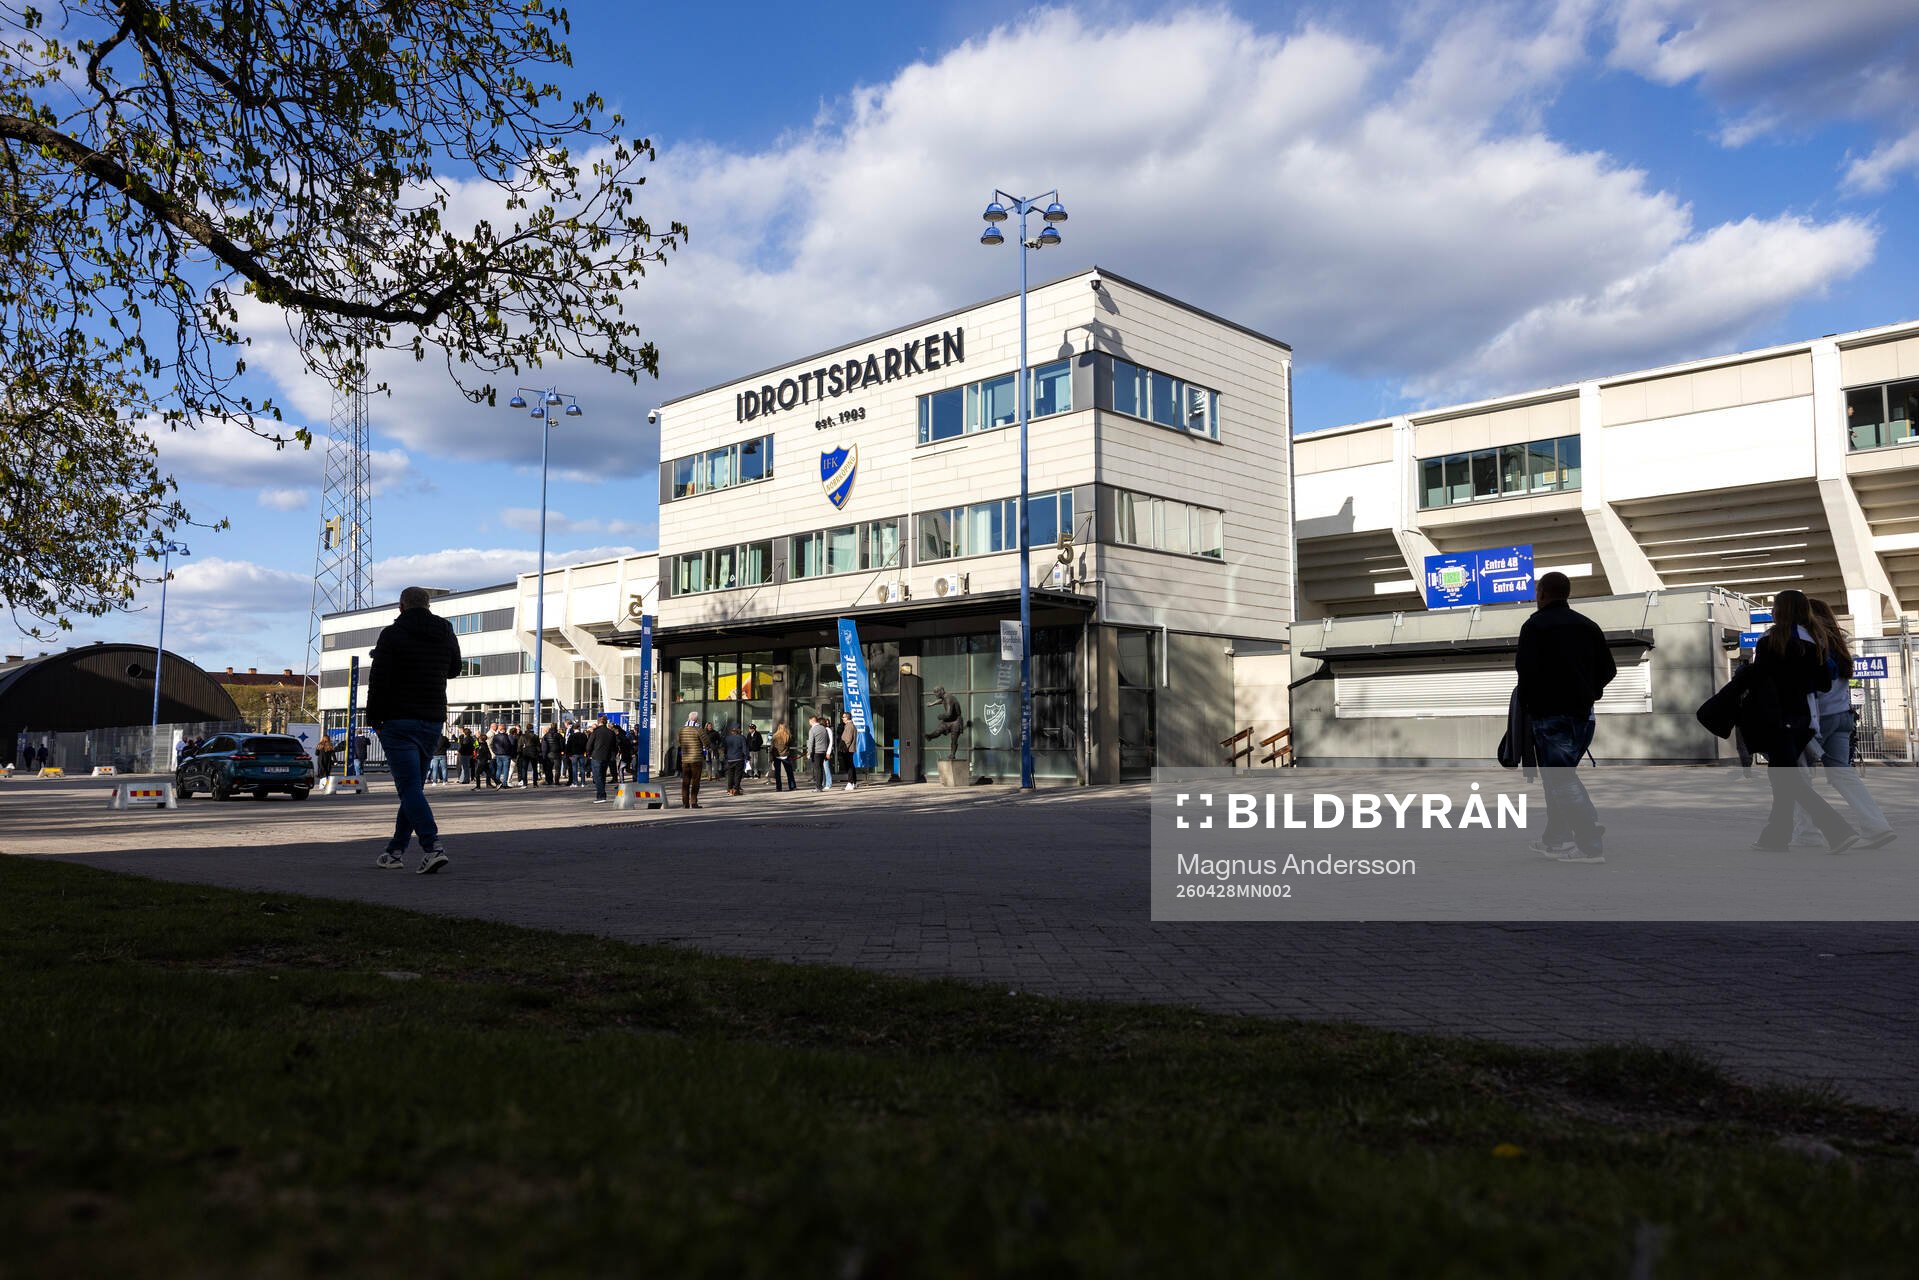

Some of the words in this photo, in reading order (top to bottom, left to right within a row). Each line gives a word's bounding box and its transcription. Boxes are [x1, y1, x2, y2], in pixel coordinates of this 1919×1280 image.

[736, 326, 965, 423] IDROTTSPARKEN
[815, 416, 836, 430] est.
[839, 407, 865, 424] 1903
[823, 456, 839, 470] IFK
[1484, 558, 1506, 570] Entré
[1507, 556, 1519, 568] 4B
[1493, 582, 1515, 593] Entré
[1516, 580, 1527, 591] 4A
[1852, 659, 1868, 670] tré
[1870, 658, 1884, 670] 4A
